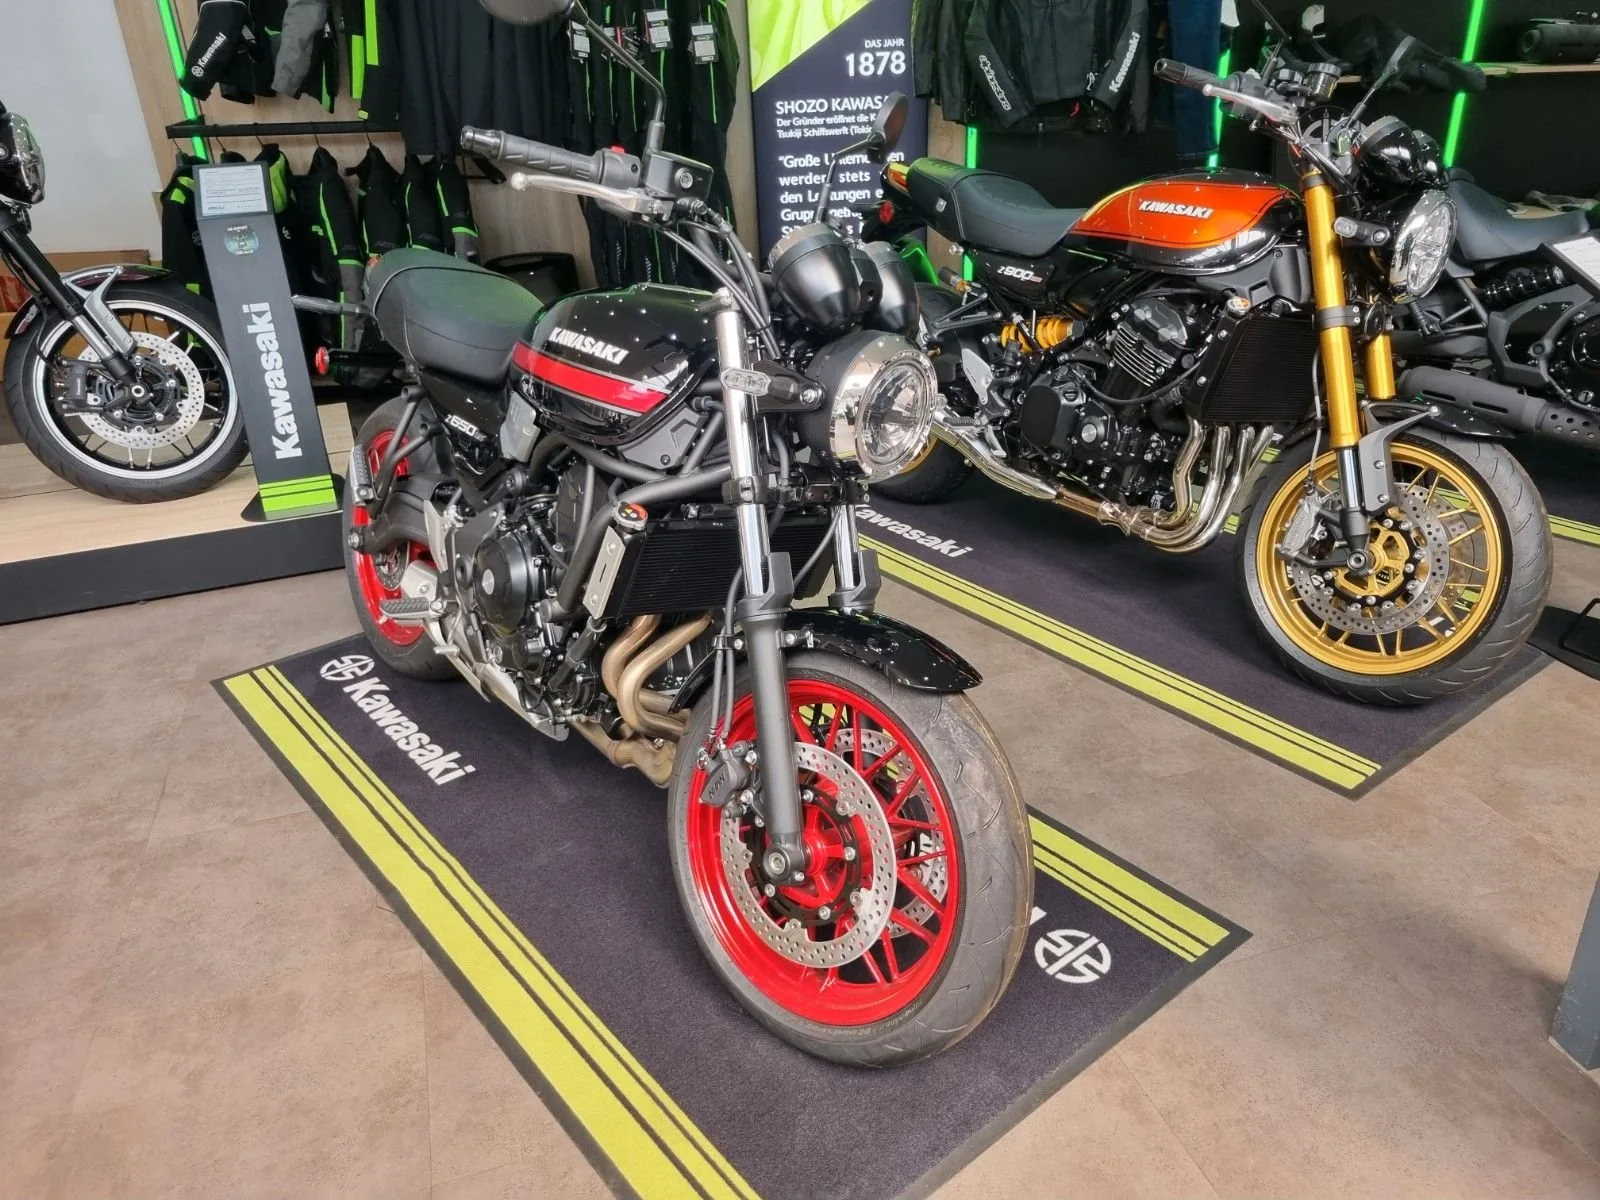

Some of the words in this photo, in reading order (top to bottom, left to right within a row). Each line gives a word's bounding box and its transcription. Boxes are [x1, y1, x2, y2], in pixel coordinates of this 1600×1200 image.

[197, 31, 227, 68] Kawasaki
[864, 38, 882, 49] DAS
[883, 37, 905, 48] JAHR
[845, 50, 906, 77] 1878
[1108, 31, 1141, 93] Kawasaki
[775, 98, 828, 115] SHOZO
[776, 117, 791, 127] Der
[792, 116, 825, 126] Gründer
[857, 112, 869, 123] die
[839, 171, 871, 183] stets
[780, 191, 803, 204] den
[1138, 200, 1214, 219] KAWASAKI
[549, 327, 629, 366] KAWASAKI
[242, 302, 303, 460] Kawasaki
[343, 677, 477, 786] Kawasaki
